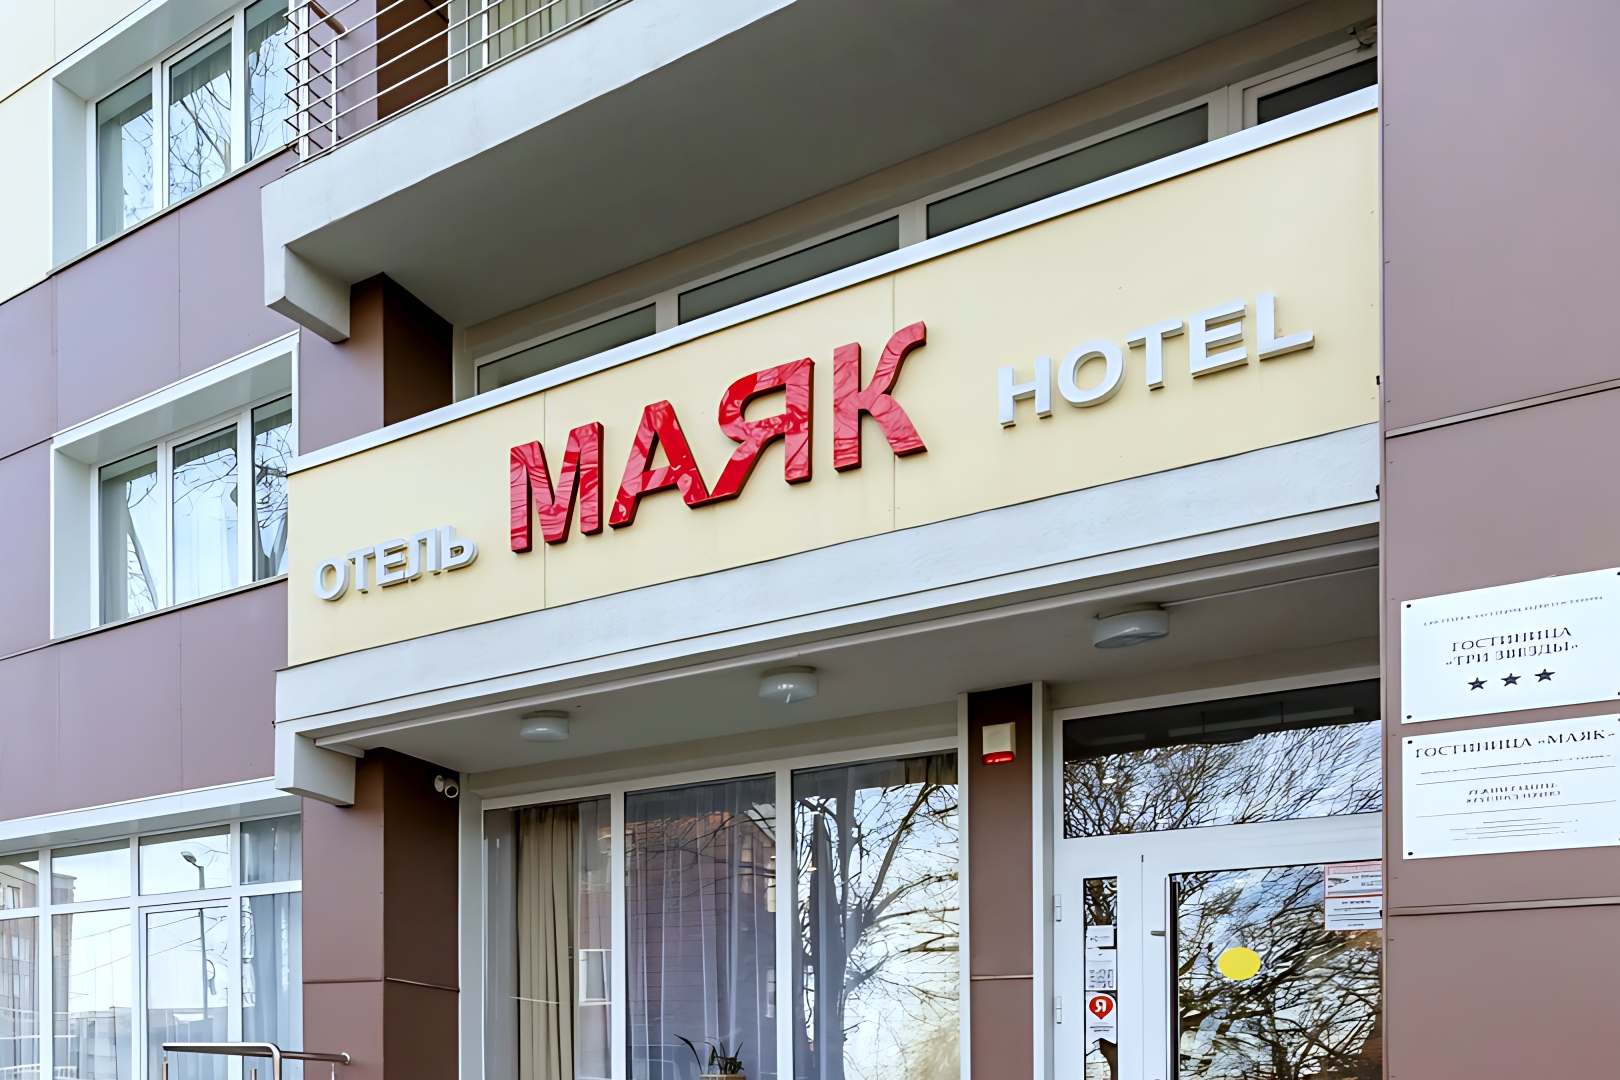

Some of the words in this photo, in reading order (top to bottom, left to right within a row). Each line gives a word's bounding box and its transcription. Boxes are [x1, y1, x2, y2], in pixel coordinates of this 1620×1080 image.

[313, 525, 479, 601] ОТЕЛЬ
[510, 320, 928, 554] МАЯК
[998, 291, 1315, 428] HOTEL
